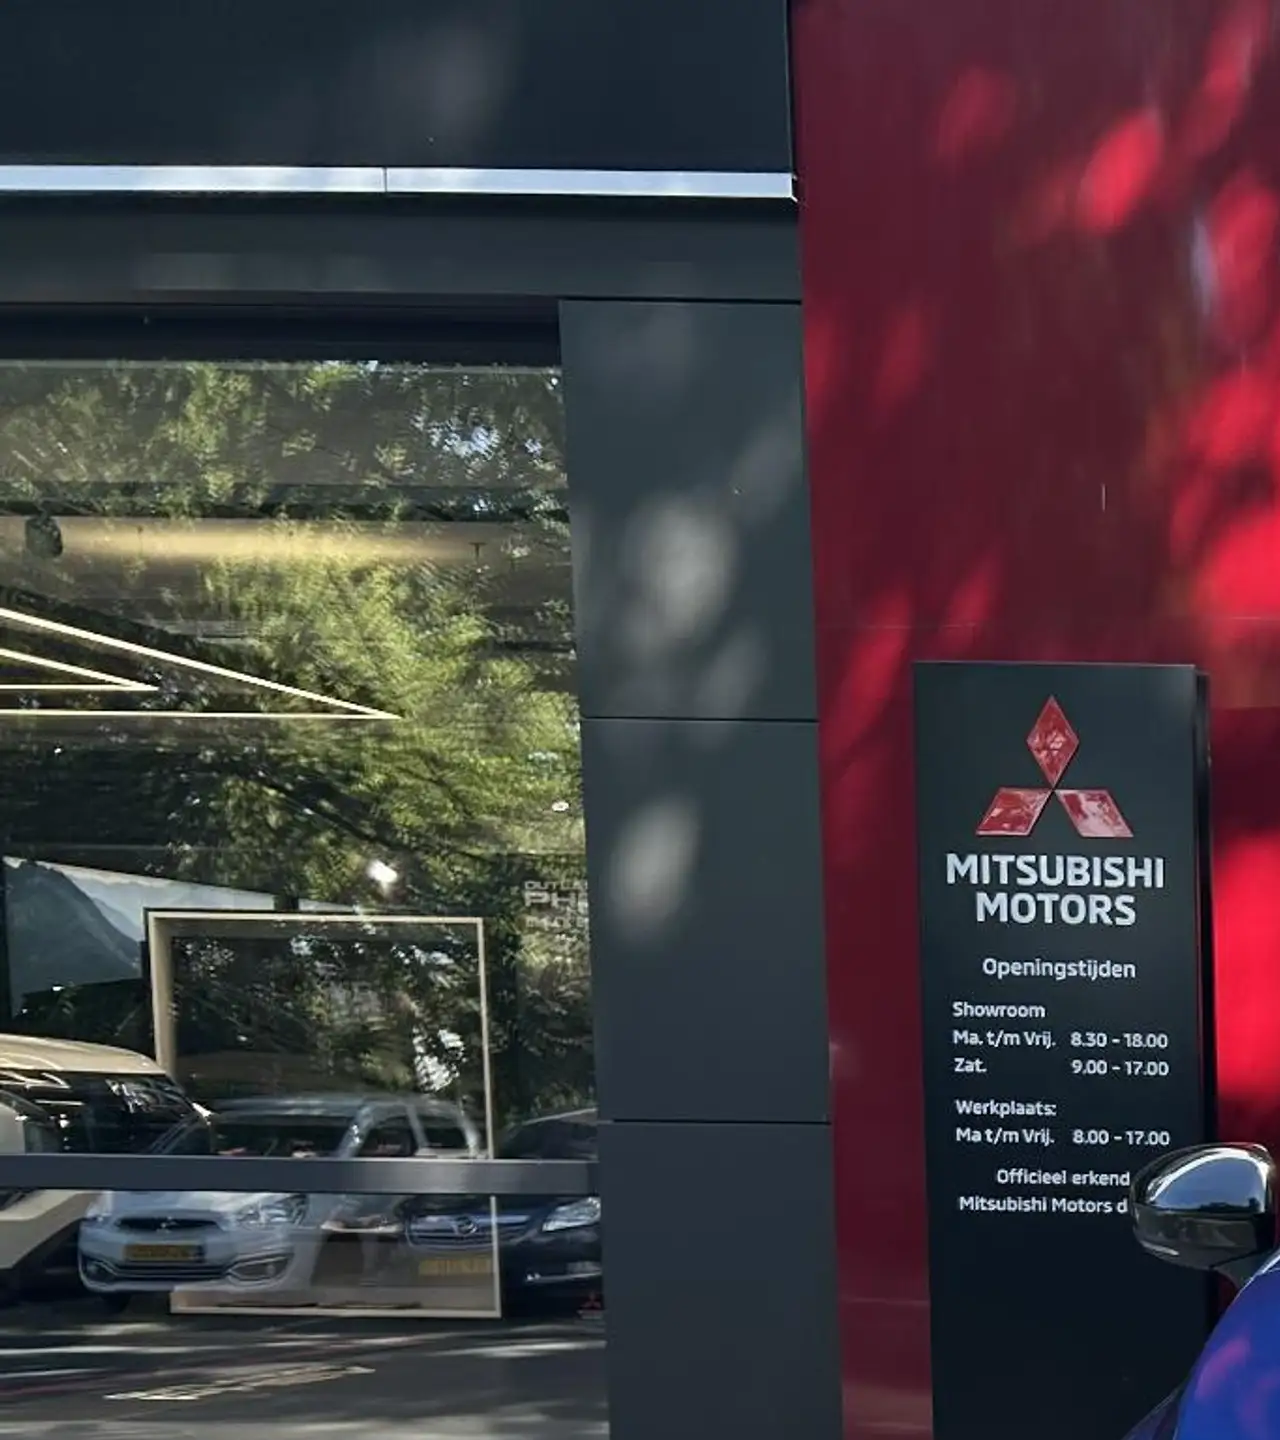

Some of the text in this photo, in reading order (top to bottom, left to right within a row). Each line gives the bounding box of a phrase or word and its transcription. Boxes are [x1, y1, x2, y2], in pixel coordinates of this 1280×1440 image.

[946, 853, 1164, 888] MITSUBISHI
[976, 892, 1136, 926] MOTORS
[982, 957, 1136, 981] Openingstijden
[952, 1001, 1046, 1018] Showroom
[953, 1029, 983, 1046] Ma.
[986, 1030, 1021, 1048] t/m
[1023, 1030, 1057, 1050] Vrij.
[1070, 1031, 1108, 1048] 8.30
[1123, 1032, 1169, 1049] 18.00
[954, 1057, 987, 1073] Zat.
[1071, 1059, 1108, 1075] 9.00
[1124, 1060, 1170, 1076] 17.00
[955, 1099, 1057, 1119] Werkplaats:
[955, 1127, 982, 1143] Ma
[985, 1127, 1020, 1145] t/m
[1022, 1128, 1055, 1147] Vrij.
[1072, 1128, 1110, 1145] 8.00
[1126, 1130, 1171, 1146] 17.00
[996, 1167, 1131, 1187] Officieel erkend
[959, 1195, 1048, 1213] Mitsubishi
[1051, 1197, 1113, 1214] Motors
